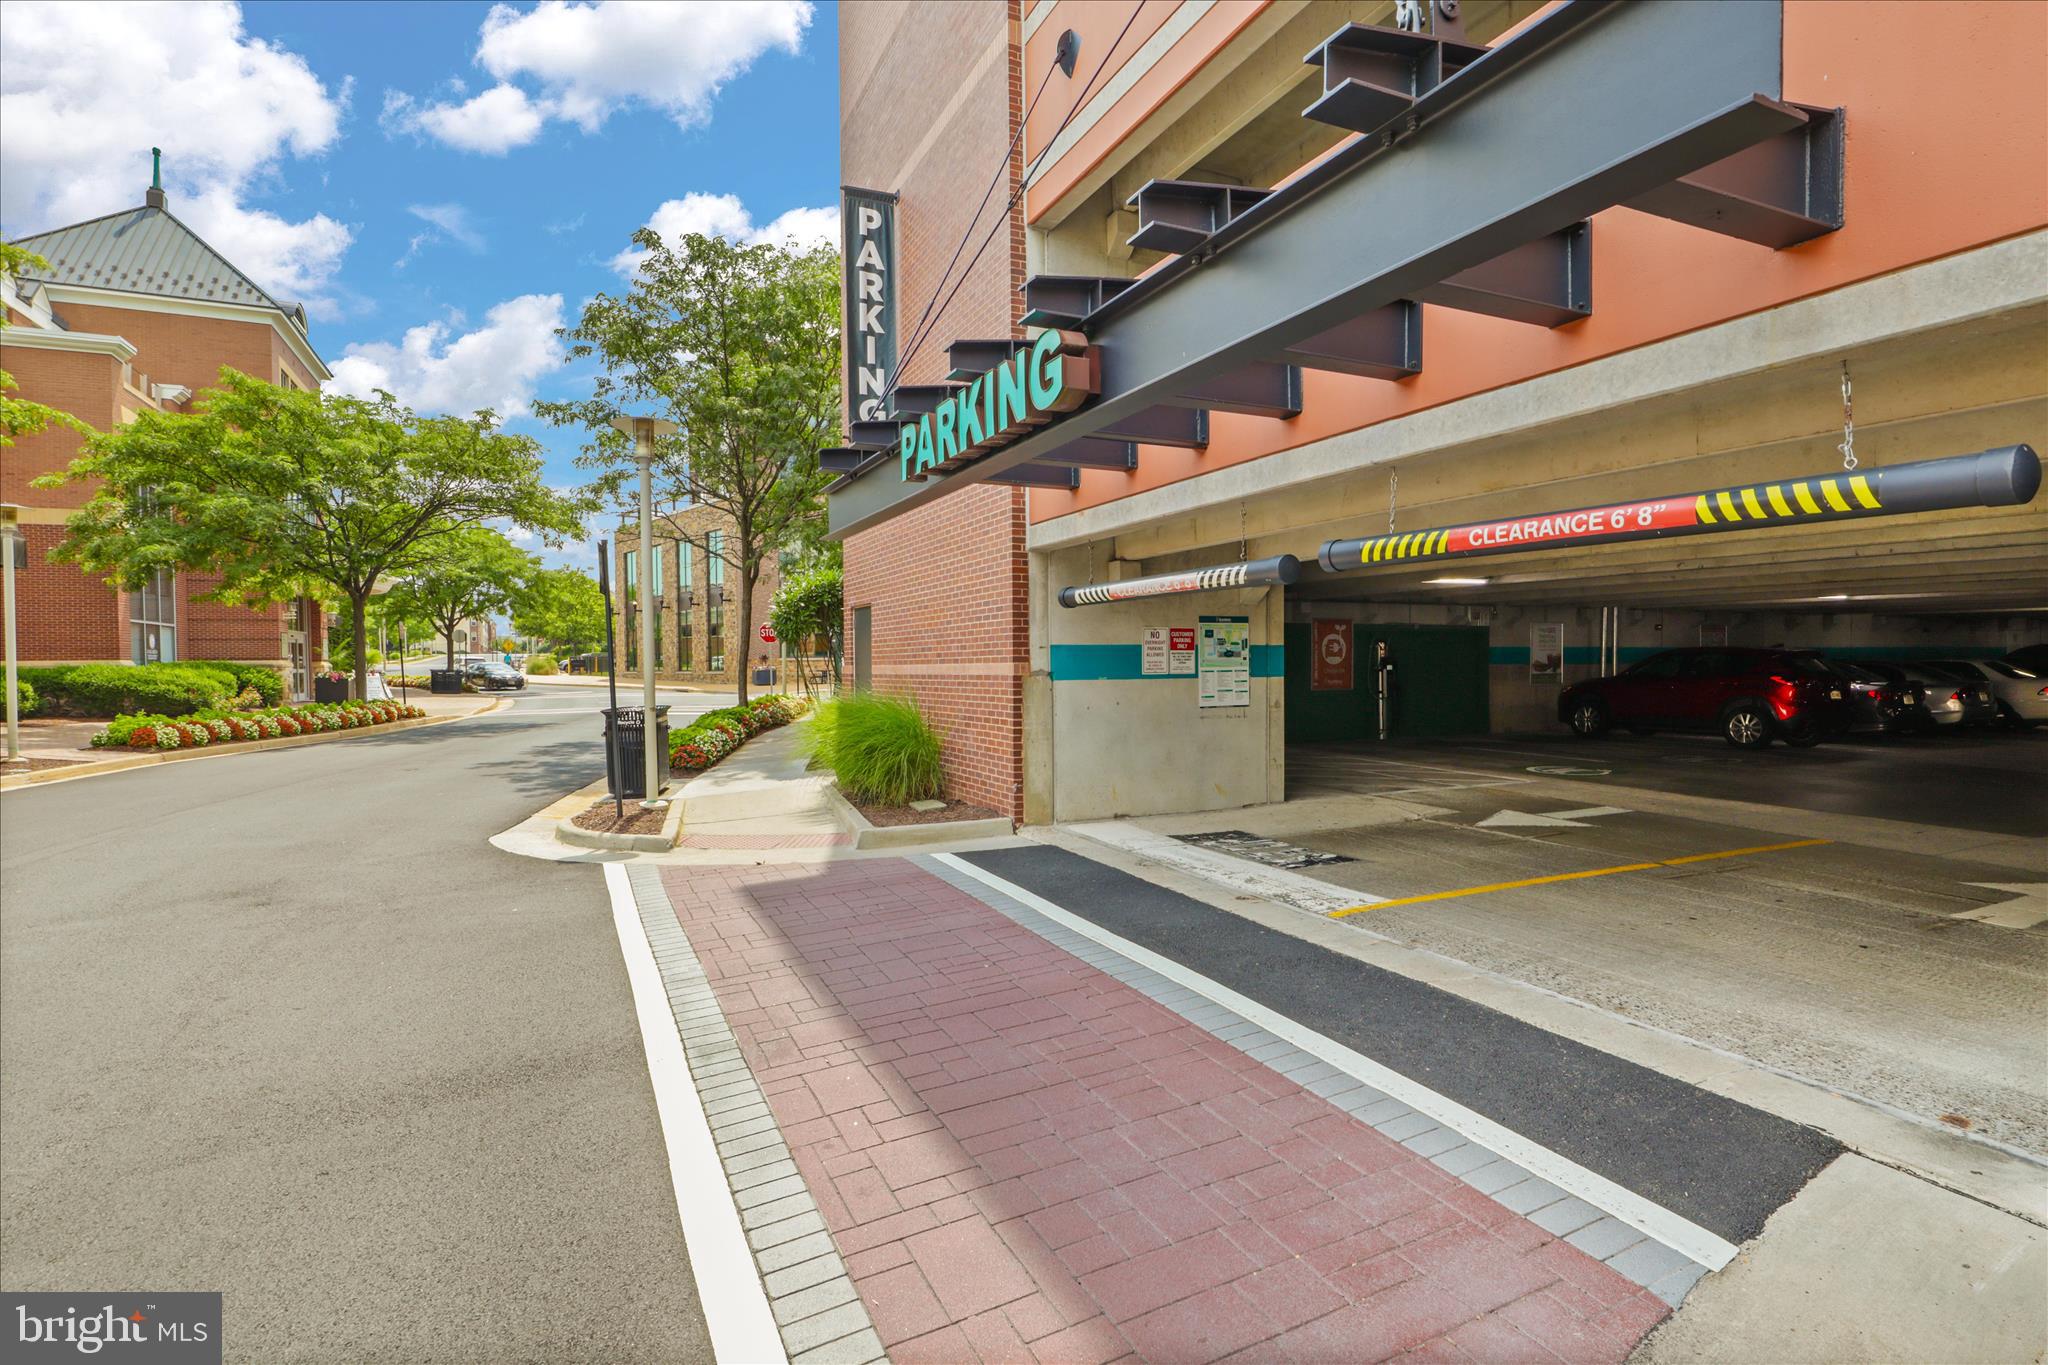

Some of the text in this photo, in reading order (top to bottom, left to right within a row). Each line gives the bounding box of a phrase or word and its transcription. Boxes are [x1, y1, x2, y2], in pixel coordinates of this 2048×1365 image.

[856, 206, 886, 421] PARKING
[900, 328, 1064, 482] PARKING
[1469, 511, 1605, 546] CLEARANCE
[761, 629, 776, 637] STO
[1150, 631, 1160, 639] NO
